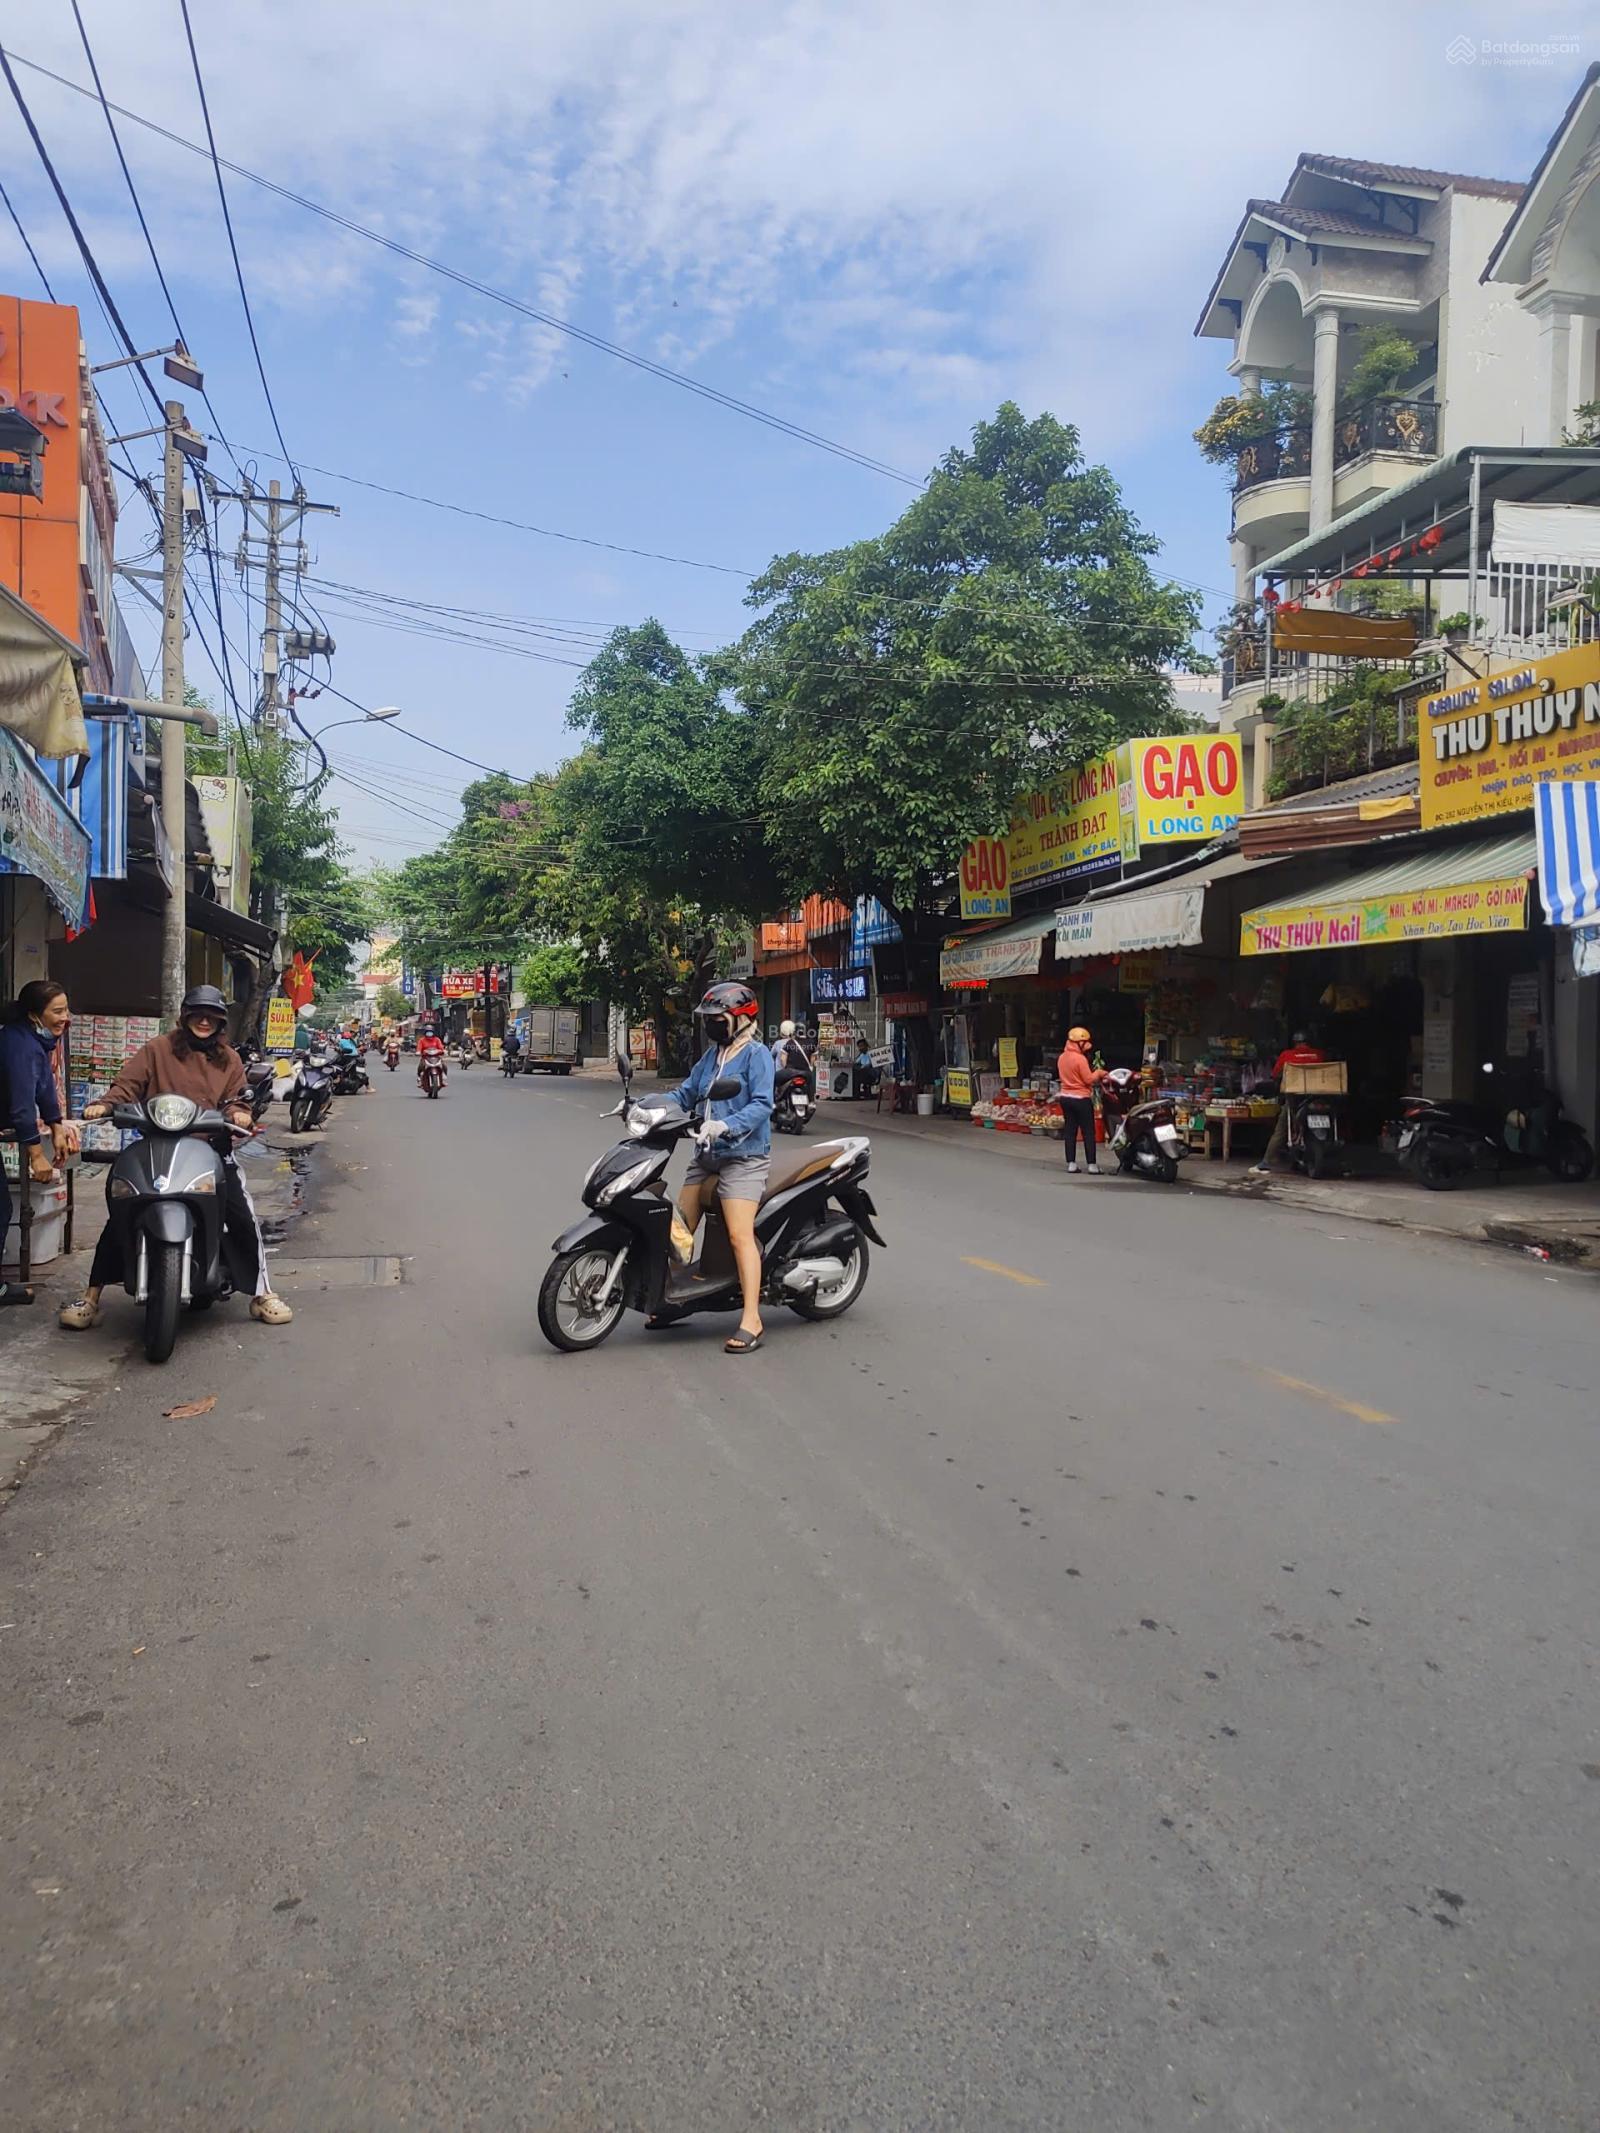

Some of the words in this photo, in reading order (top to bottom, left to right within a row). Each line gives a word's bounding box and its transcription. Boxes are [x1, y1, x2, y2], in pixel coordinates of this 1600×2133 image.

[1488, 669, 1537, 700] SALON
[1432, 713, 1490, 760] THU
[1494, 677, 1578, 745] THỦY
[1101, 760, 1116, 794] AN
[1144, 741, 1238, 810] GẠO
[1081, 811, 1107, 838] ĐẠT
[1149, 815, 1204, 836] LONG
[1211, 815, 1238, 832] AN
[962, 839, 1007, 896] GẠO
[966, 898, 992, 915] LONG
[995, 897, 1009, 914] AN
[1389, 903, 1406, 918] NAIL
[1428, 898, 1438, 913] MI
[1444, 892, 1480, 912] MAKEUP
[1256, 926, 1282, 950] THU
[1287, 911, 1324, 946] THỦY
[1328, 915, 1360, 943] Nail
[462, 977, 474, 985] XE
